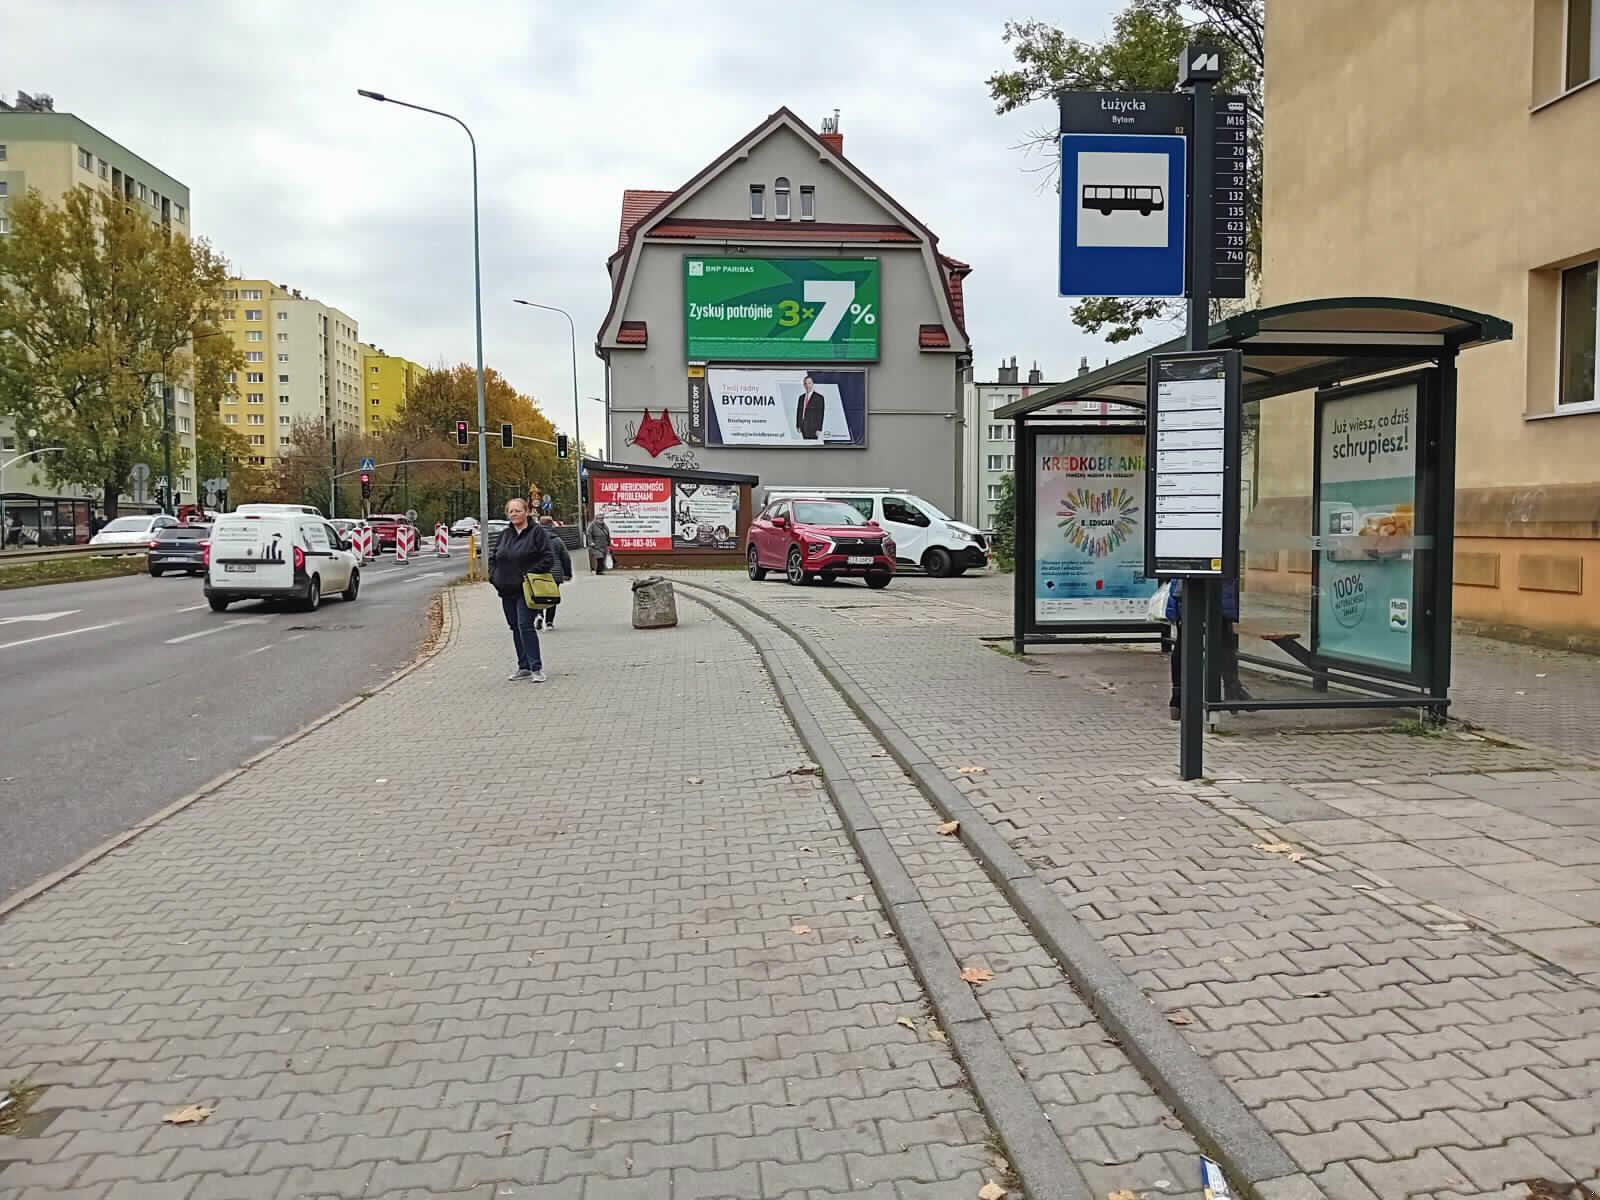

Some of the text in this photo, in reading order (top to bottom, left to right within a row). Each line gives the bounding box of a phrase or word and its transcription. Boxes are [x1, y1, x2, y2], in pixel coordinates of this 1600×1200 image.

[1101, 98, 1146, 112] Łużycka
[1112, 115, 1135, 124] Bytom
[1226, 117, 1244, 126] M16
[1235, 132, 1244, 141] 15
[1232, 147, 1244, 156] 20
[1232, 161, 1244, 171] 39
[1233, 176, 1244, 186] 92
[1229, 191, 1244, 201] 132
[1229, 207, 1244, 216] 135
[1227, 221, 1243, 231] 623
[1227, 236, 1243, 246] 735
[1226, 251, 1243, 261] 740
[705, 265, 755, 273] BNP PARIBAS
[690, 303, 725, 320] Zyskuj
[727, 303, 773, 321] potrójnie
[722, 395, 776, 406] BYTOMIA
[1332, 408, 1409, 434] Już wiesz, co dziś
[1333, 425, 1409, 464] schrupiesz!
[1334, 574, 1364, 599] 100%
